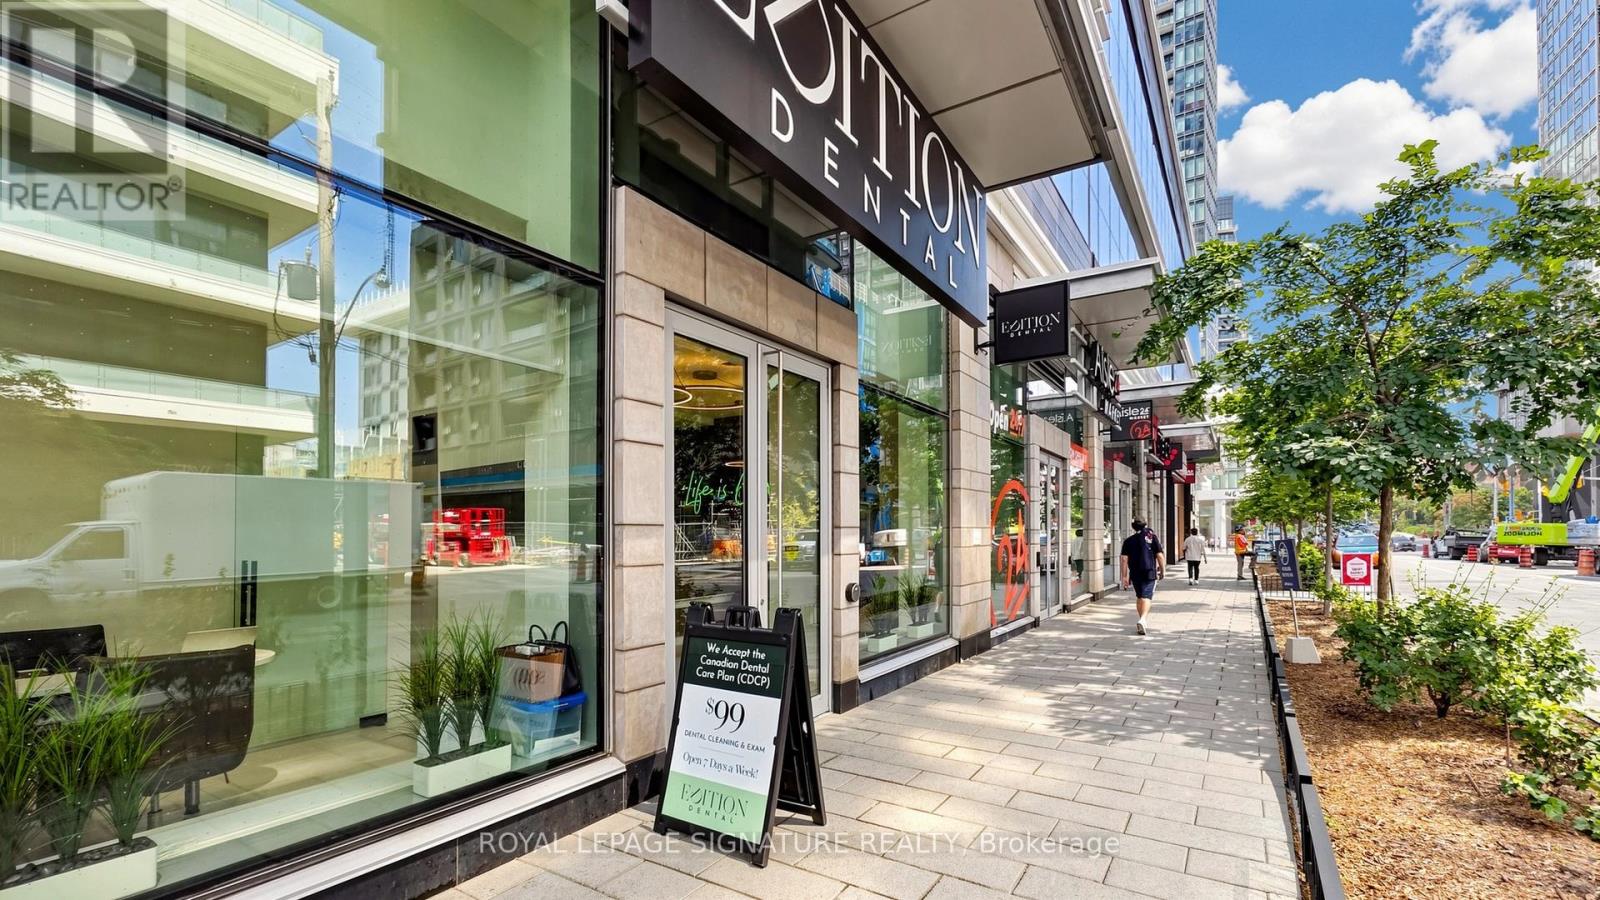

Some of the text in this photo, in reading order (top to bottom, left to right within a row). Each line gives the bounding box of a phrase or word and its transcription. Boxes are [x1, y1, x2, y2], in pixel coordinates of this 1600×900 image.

[713, 0, 986, 269] DITION
[771, 87, 958, 289] DENTAL
[1001, 311, 1060, 334] EDITION
[1010, 326, 1051, 338] DENTAL
[685, 470, 713, 514] Life
[717, 478, 727, 500] is
[707, 641, 766, 660] We Accept the
[700, 654, 770, 674] Canadian Dental
[696, 666, 771, 689] Care Plan (CDCP)
[705, 697, 745, 733] $99
[684, 729, 766, 753] DENTAL CLEANING & EXAM
[683, 751, 759, 779] Open 7 Days a Week!
[681, 783, 749, 817] EDITION
[688, 804, 734, 824] DENTAL
